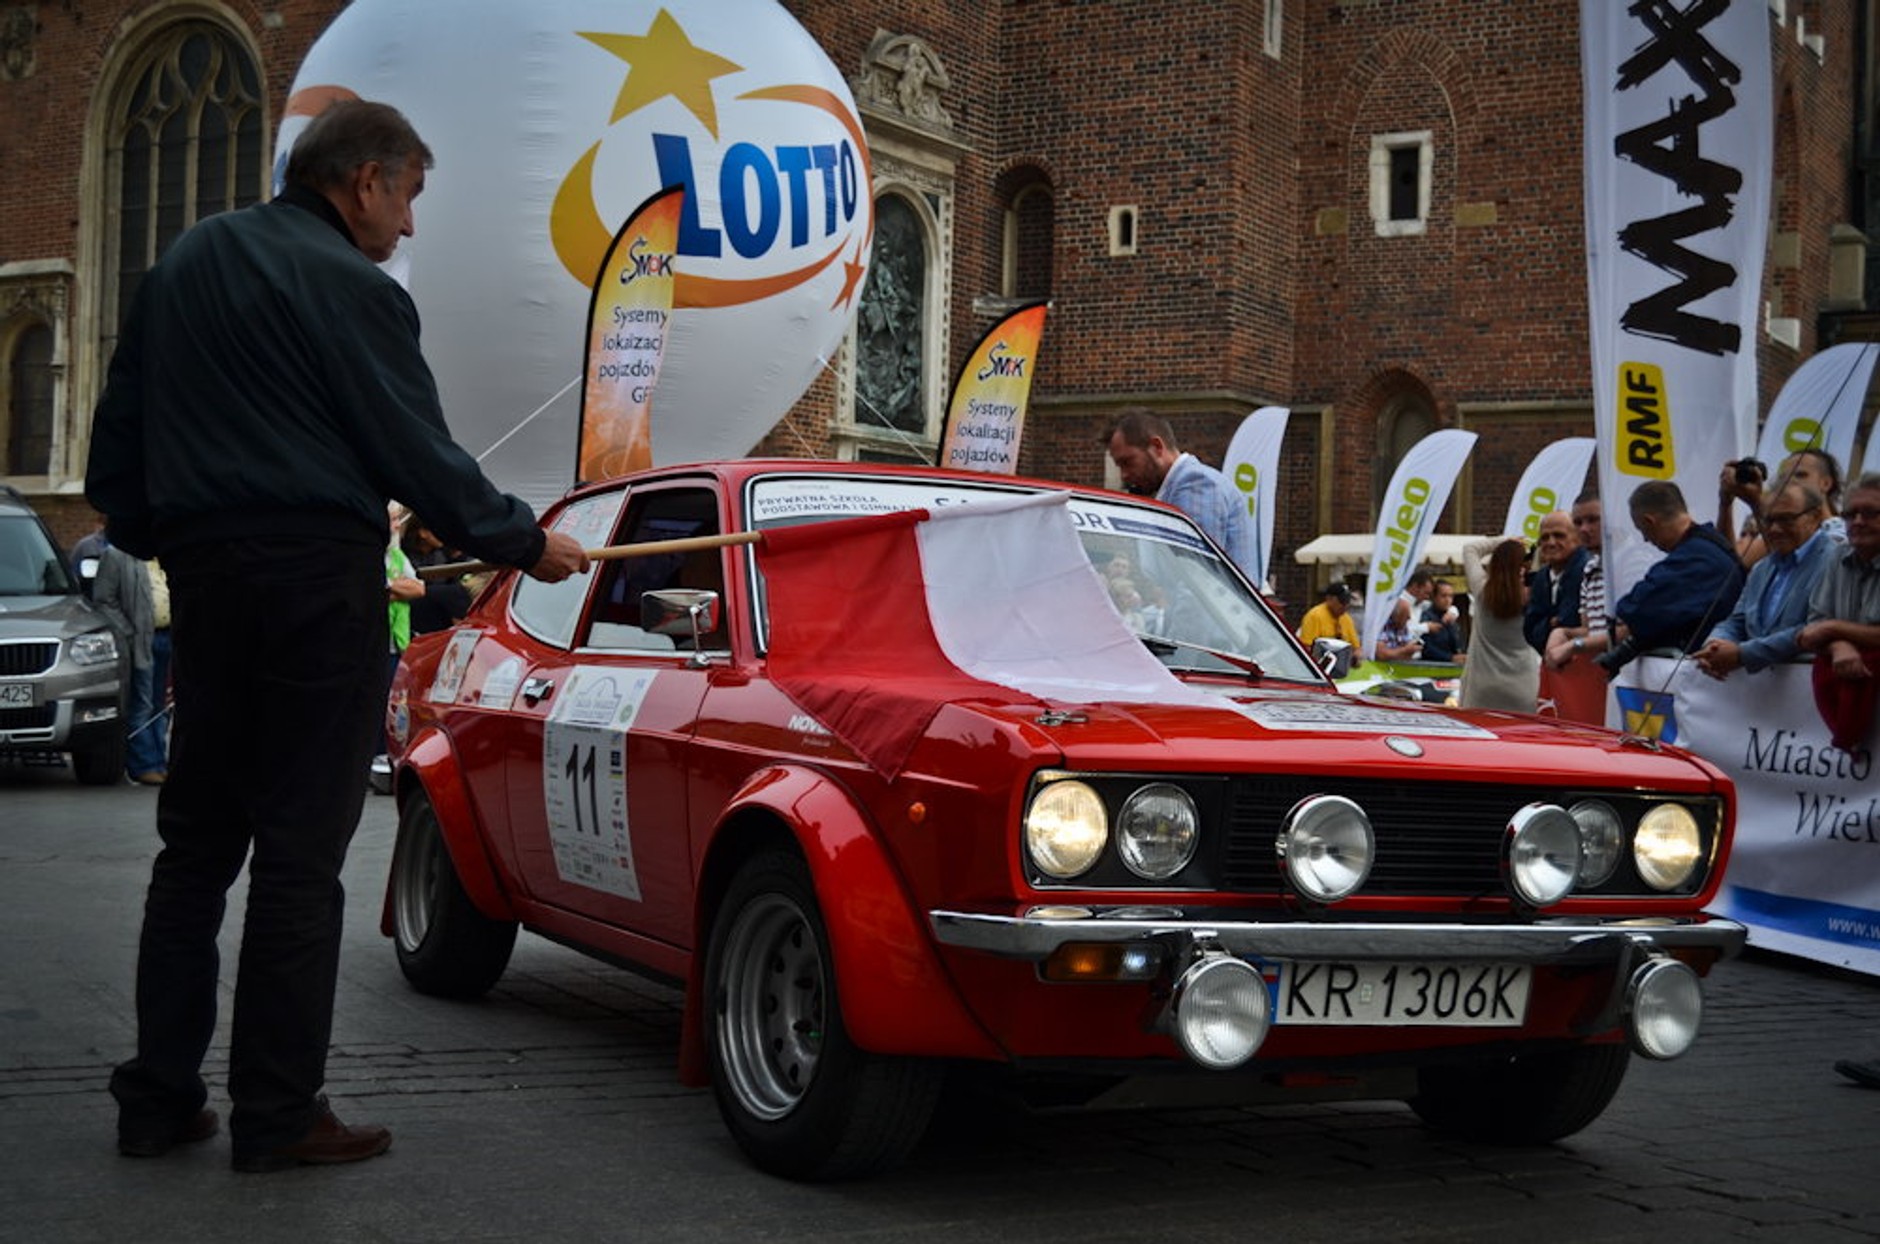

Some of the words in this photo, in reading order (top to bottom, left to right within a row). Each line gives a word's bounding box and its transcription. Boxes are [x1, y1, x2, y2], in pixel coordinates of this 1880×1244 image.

[652, 133, 857, 259] LOTTO
[1626, 369, 1665, 469] RMF
[566, 743, 600, 836] 11
[1742, 727, 1871, 781] Miasto
[1794, 790, 1880, 844] Wiel
[1286, 964, 1360, 1018] KR
[1382, 965, 1522, 1019] 1306K
